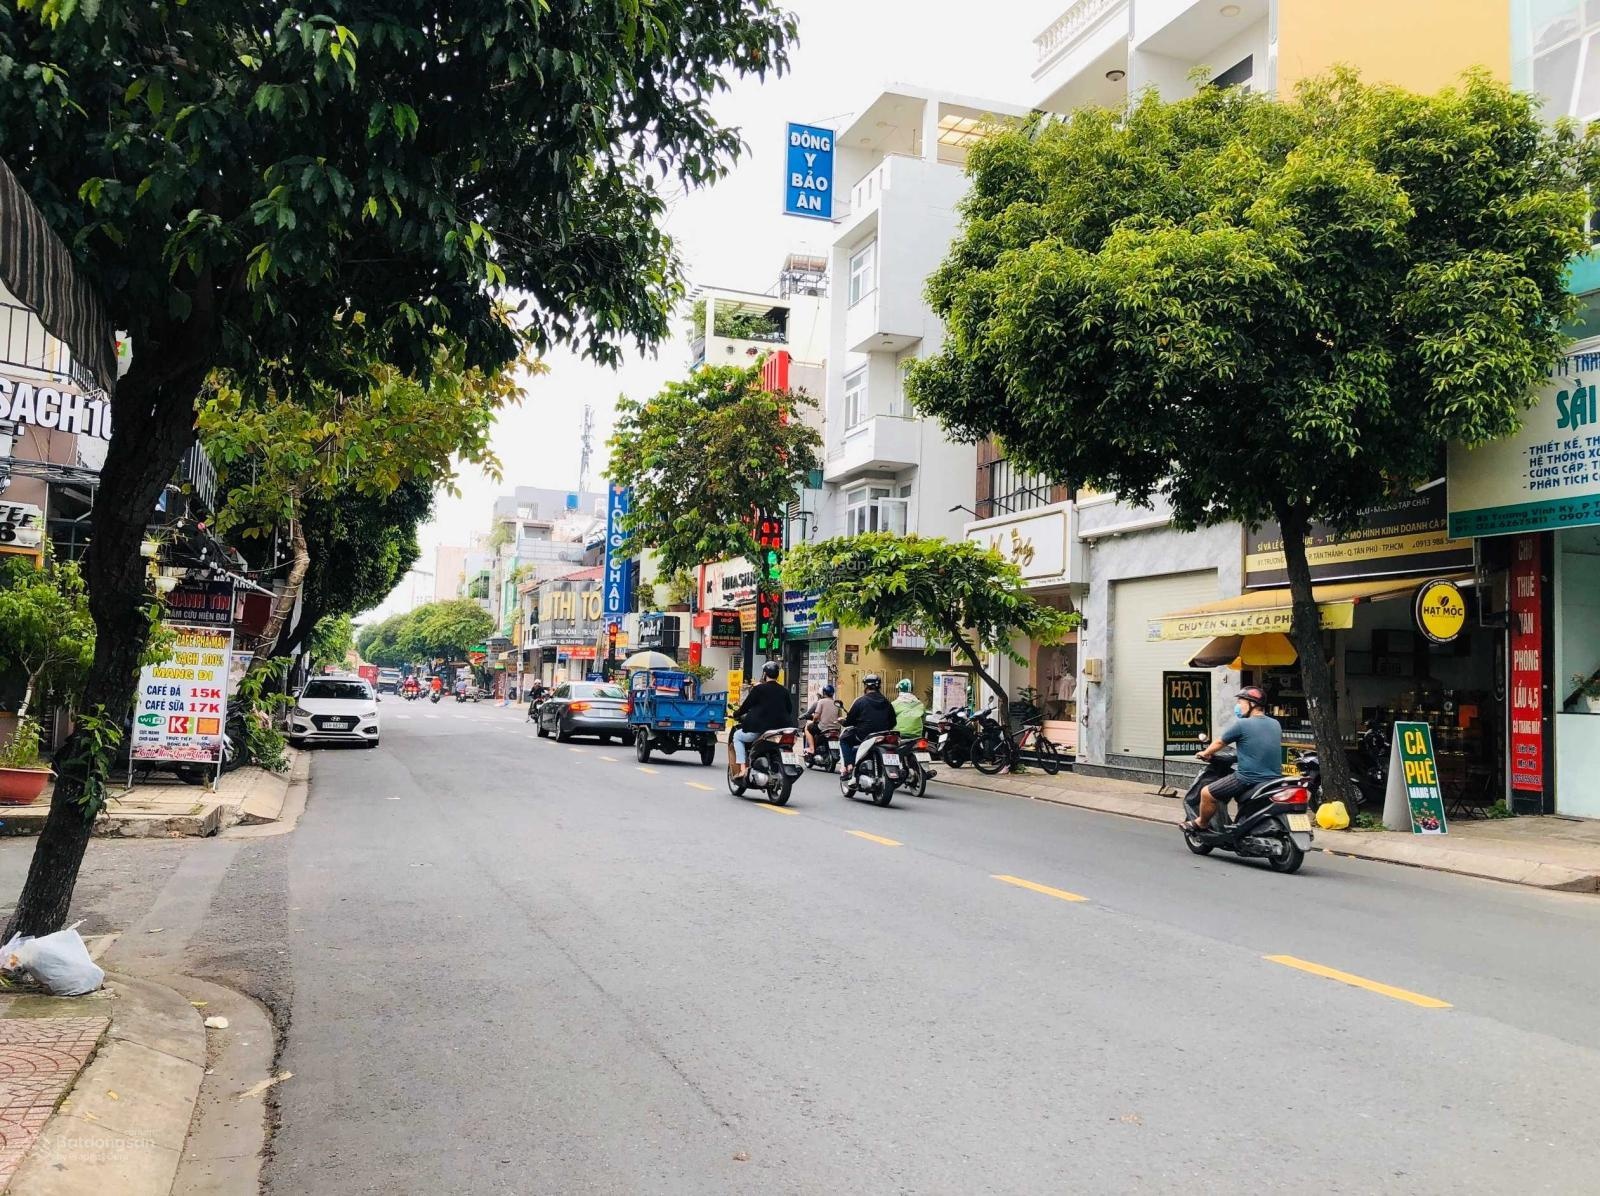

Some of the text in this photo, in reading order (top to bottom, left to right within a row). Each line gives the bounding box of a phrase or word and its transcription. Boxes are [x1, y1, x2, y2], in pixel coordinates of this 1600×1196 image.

[790, 130, 830, 152] ĐÔNG
[804, 152, 817, 167] Y
[791, 170, 828, 191] BẢO
[796, 191, 822, 211] ÂN
[1529, 440, 1560, 456] THIẾT
[610, 496, 623, 547] LONG
[1382, 524, 1399, 536] KINH
[1400, 520, 1428, 533] DOANH
[1353, 546, 1365, 554] TÂN
[608, 558, 620, 612] CHÂU
[1516, 571, 1535, 597] THUÊ
[1255, 614, 1270, 626] CÀ
[1513, 644, 1539, 671] PHÒNG
[153, 667, 214, 681] MANG ĐI
[147, 684, 221, 699] CAFÉ ĐÁ 15K
[1171, 681, 1203, 700] HẠT
[145, 699, 220, 713] CAFÉ SỮA 17K
[1171, 703, 1203, 728] MỘC
[1404, 728, 1427, 755] CÀ
[1404, 758, 1436, 784] PHÊ
[1408, 786, 1430, 799] MANG
